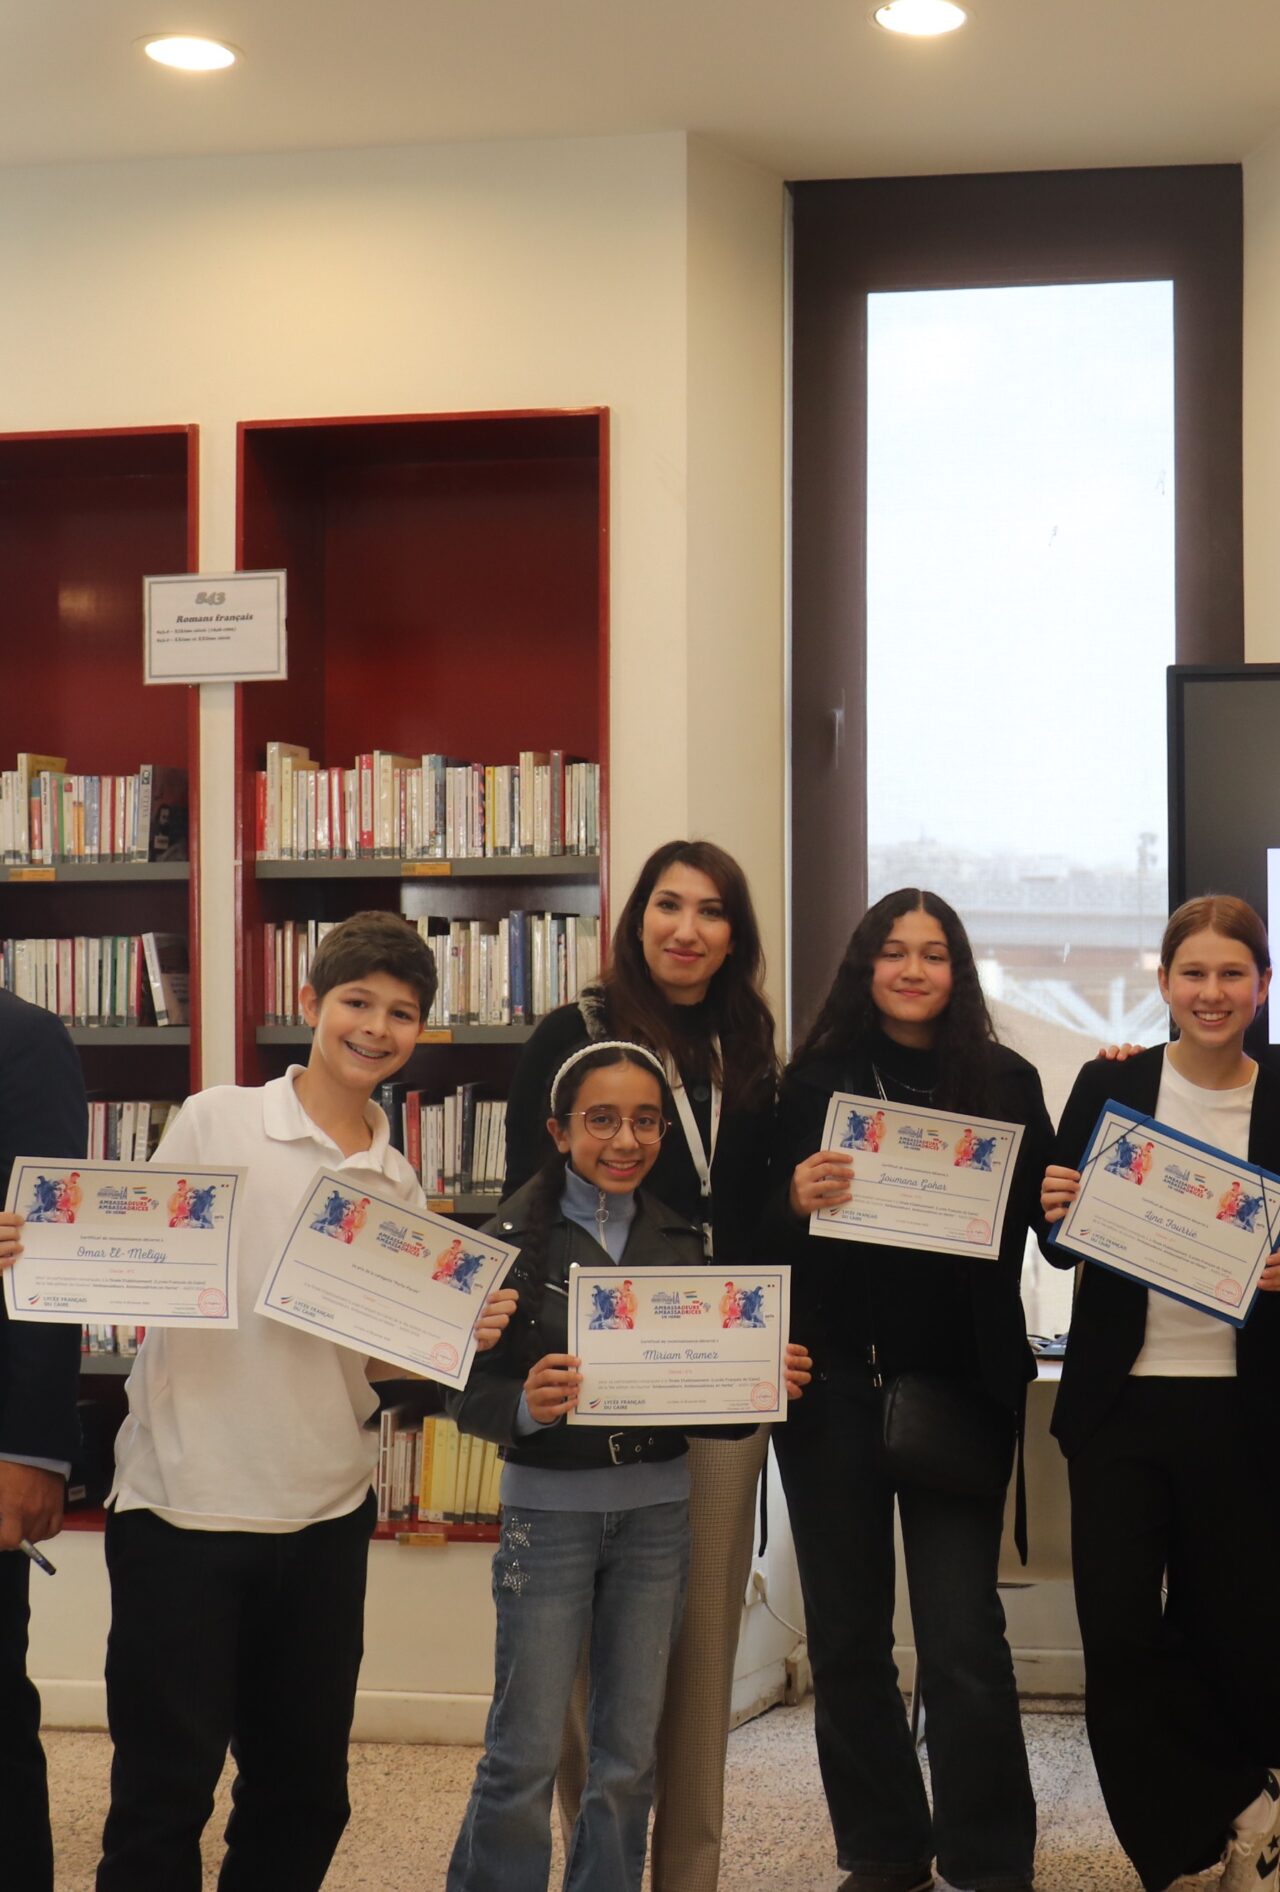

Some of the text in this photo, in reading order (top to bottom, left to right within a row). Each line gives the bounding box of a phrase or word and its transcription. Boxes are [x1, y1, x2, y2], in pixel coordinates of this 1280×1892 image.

[176, 613, 254, 623] Romans français
[77, 1246, 106, 1258] Omar
[127, 1248, 167, 1264] Meligy
[642, 1349, 682, 1361] Miriam
